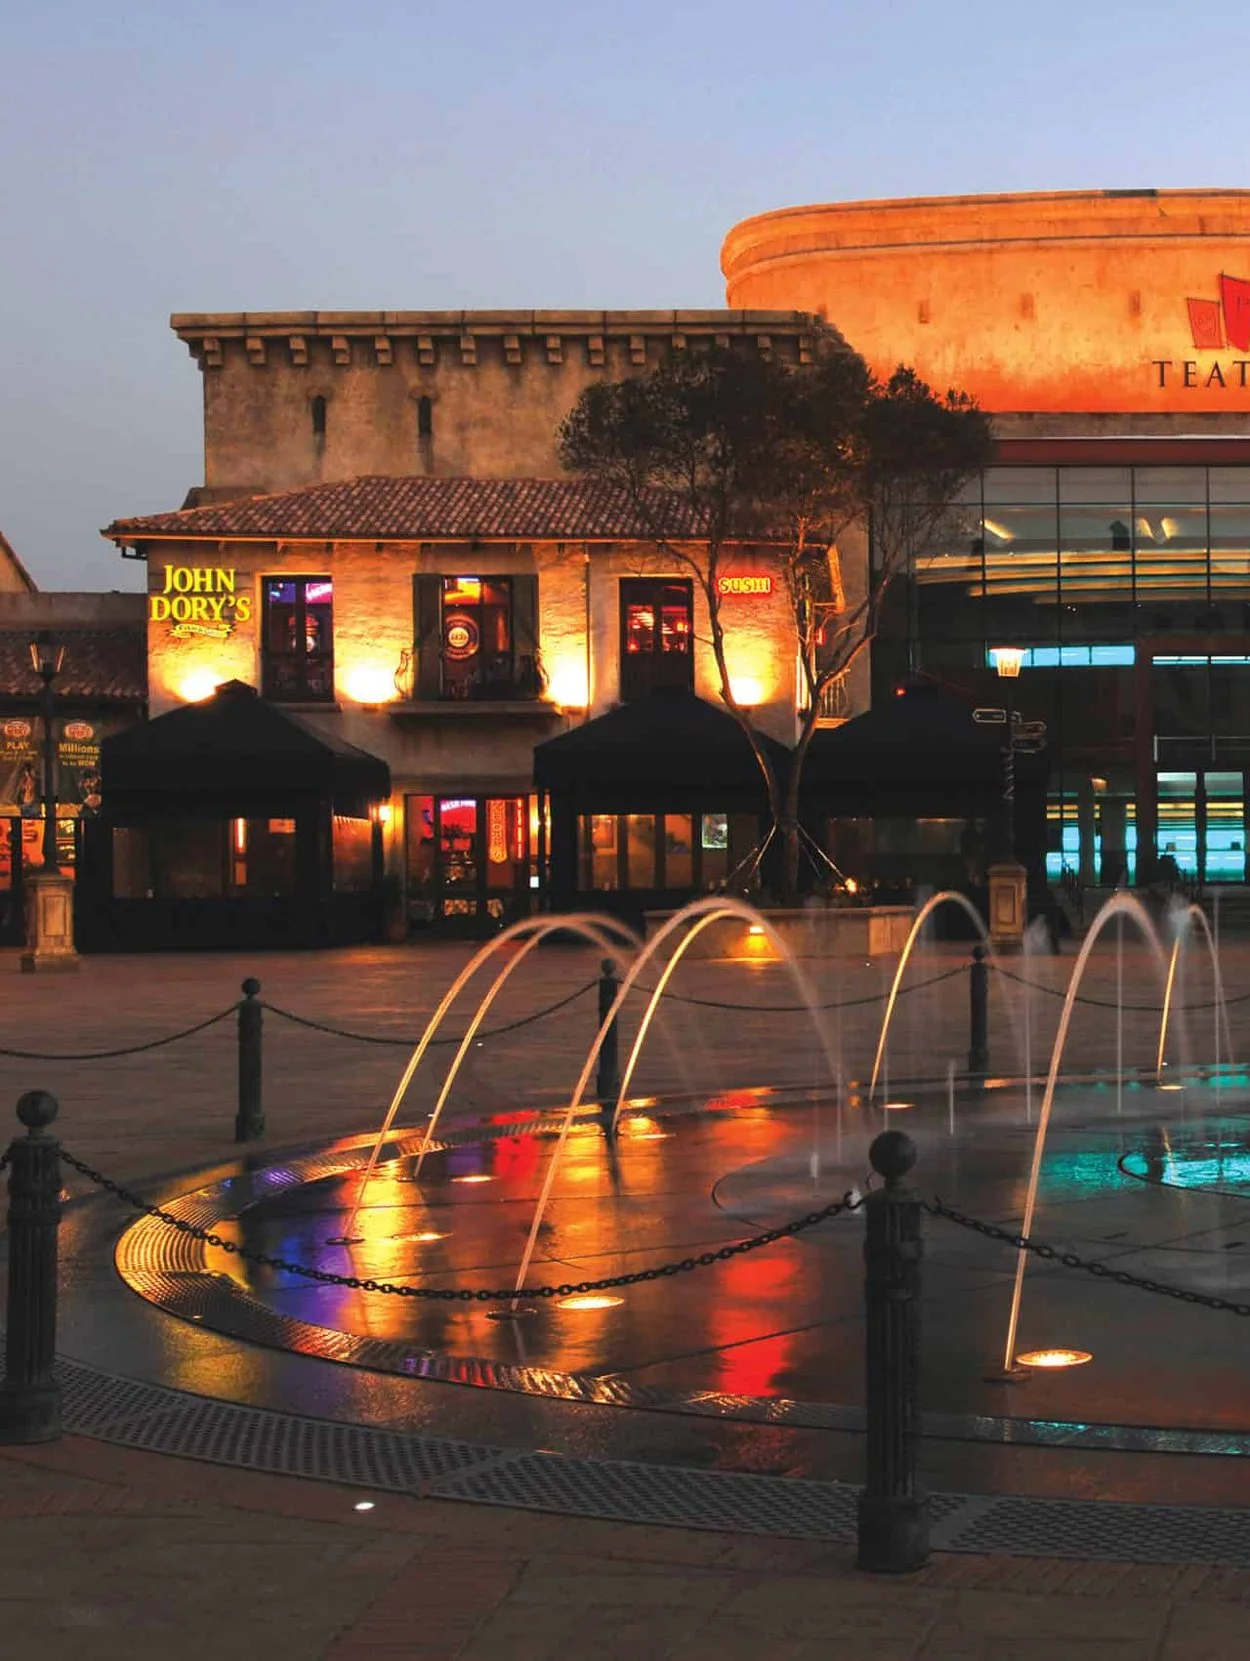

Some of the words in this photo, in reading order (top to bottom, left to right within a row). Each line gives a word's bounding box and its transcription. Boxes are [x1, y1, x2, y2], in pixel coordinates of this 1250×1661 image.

[163, 565, 236, 594] JOHN
[719, 577, 771, 594] SUSHI
[150, 593, 251, 621] DORY'S
[6, 741, 29, 750] PLAY
[59, 743, 100, 754] Millions
